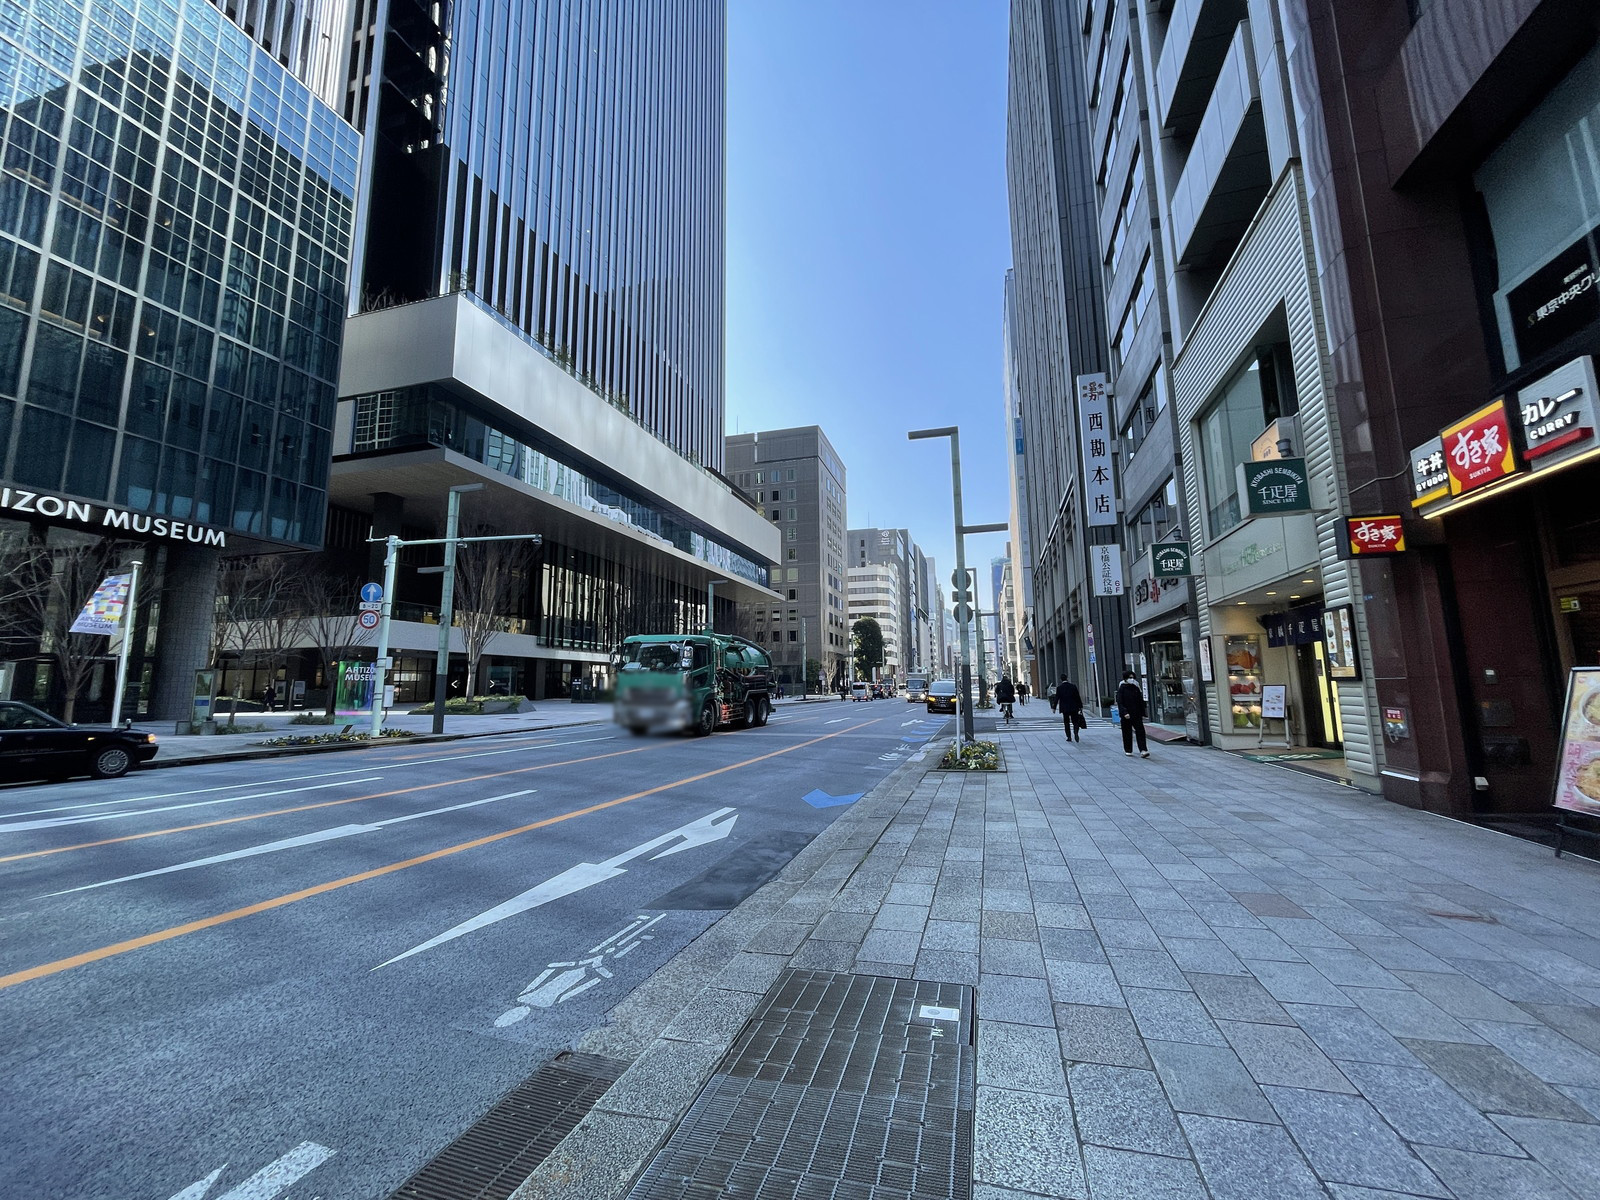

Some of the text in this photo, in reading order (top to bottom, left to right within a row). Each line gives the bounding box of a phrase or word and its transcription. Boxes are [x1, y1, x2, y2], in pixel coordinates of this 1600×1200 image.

[1522, 389, 1577, 425] カレー
[1530, 413, 1573, 440] CURRY
[1451, 424, 1503, 470] すき家
[1088, 412, 1110, 514] 西勘本店
[1417, 451, 1443, 476] 牛丼
[1469, 466, 1491, 480] SUKIYA
[1250, 468, 1273, 488] KYOBASHI
[1257, 484, 1298, 500] 千疋屋
[1, 487, 226, 548] IZON MUSEUM
[1354, 521, 1398, 543] すき家
[1100, 546, 1113, 595] 京橋公証役場
[1159, 558, 1184, 569] 千疋屋
[363, 616, 375, 625] 50
[345, 666, 375, 674] ARTIZO
[345, 673, 374, 681] MUSEU
